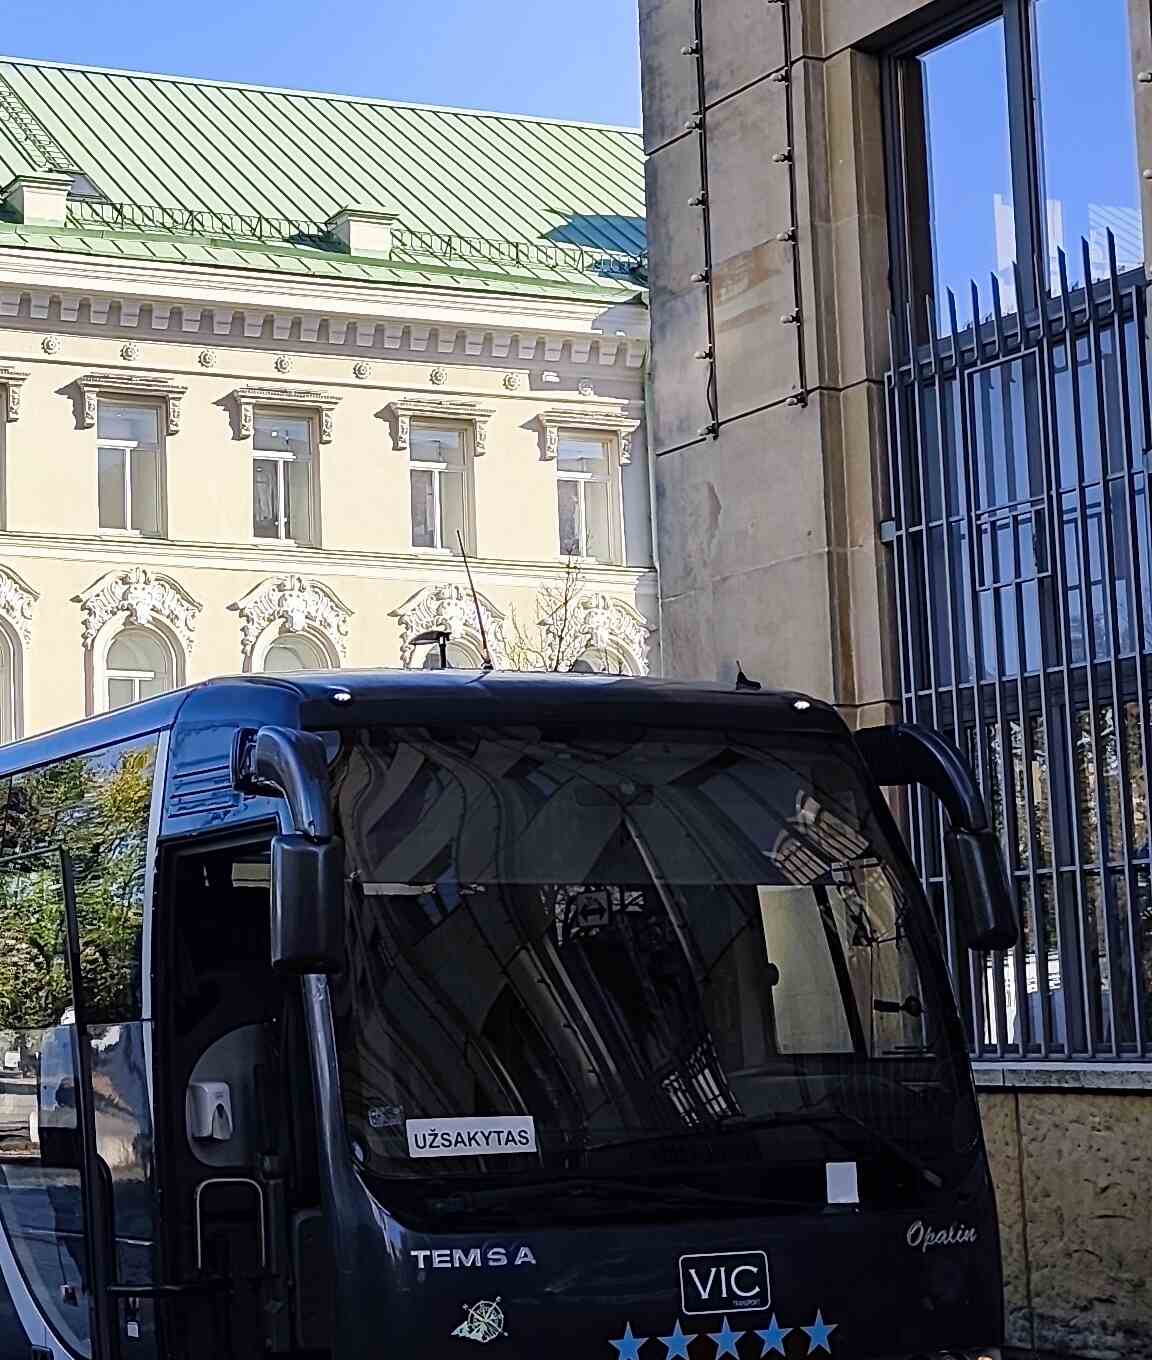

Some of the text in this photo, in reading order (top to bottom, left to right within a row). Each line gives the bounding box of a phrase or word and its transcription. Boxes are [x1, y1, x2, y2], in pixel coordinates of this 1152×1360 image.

[413, 1128, 530, 1150] UŽSAKYTAS
[906, 1220, 977, 1253] Opalin
[410, 1246, 537, 1269] TEMSA
[688, 1265, 761, 1299] VIC
